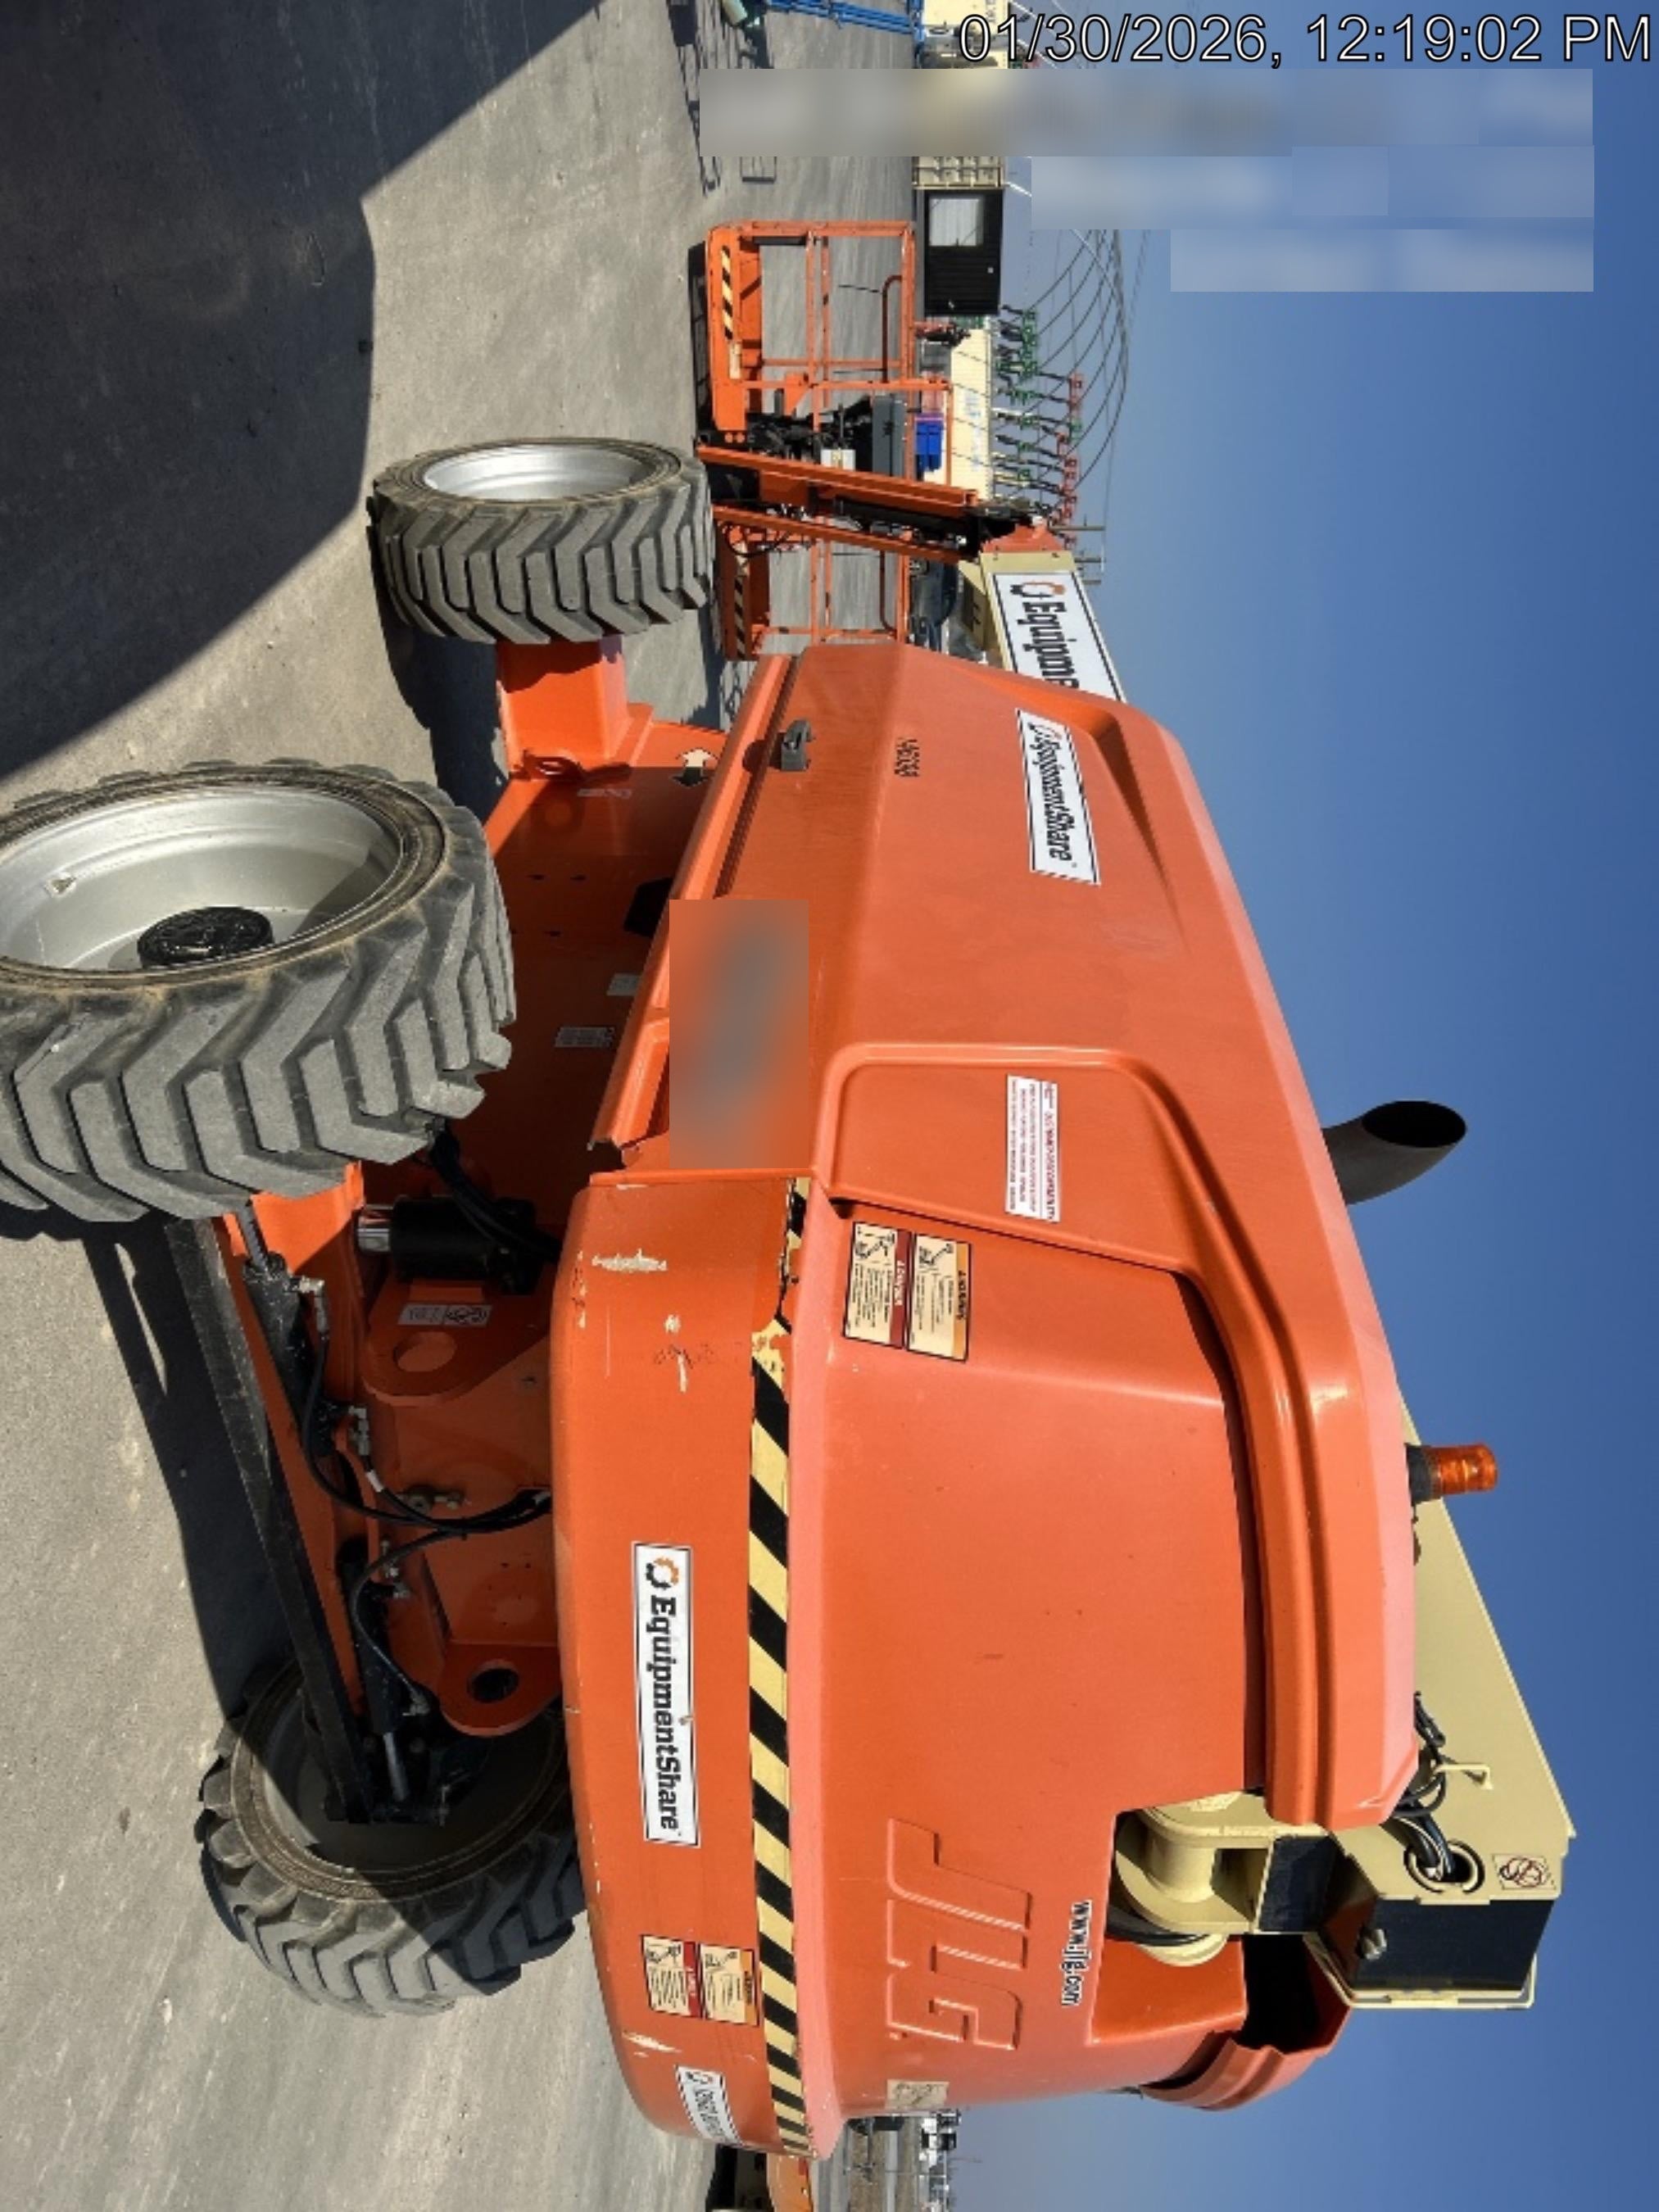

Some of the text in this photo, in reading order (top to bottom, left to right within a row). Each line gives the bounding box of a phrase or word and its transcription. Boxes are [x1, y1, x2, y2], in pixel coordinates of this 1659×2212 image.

[1031, 735, 1075, 862] EquipmentShare
[646, 1594, 682, 1830] EquipmentShare
[886, 1818, 1033, 2051] JLG
[1061, 1901, 1091, 2006] www.jlg.com
